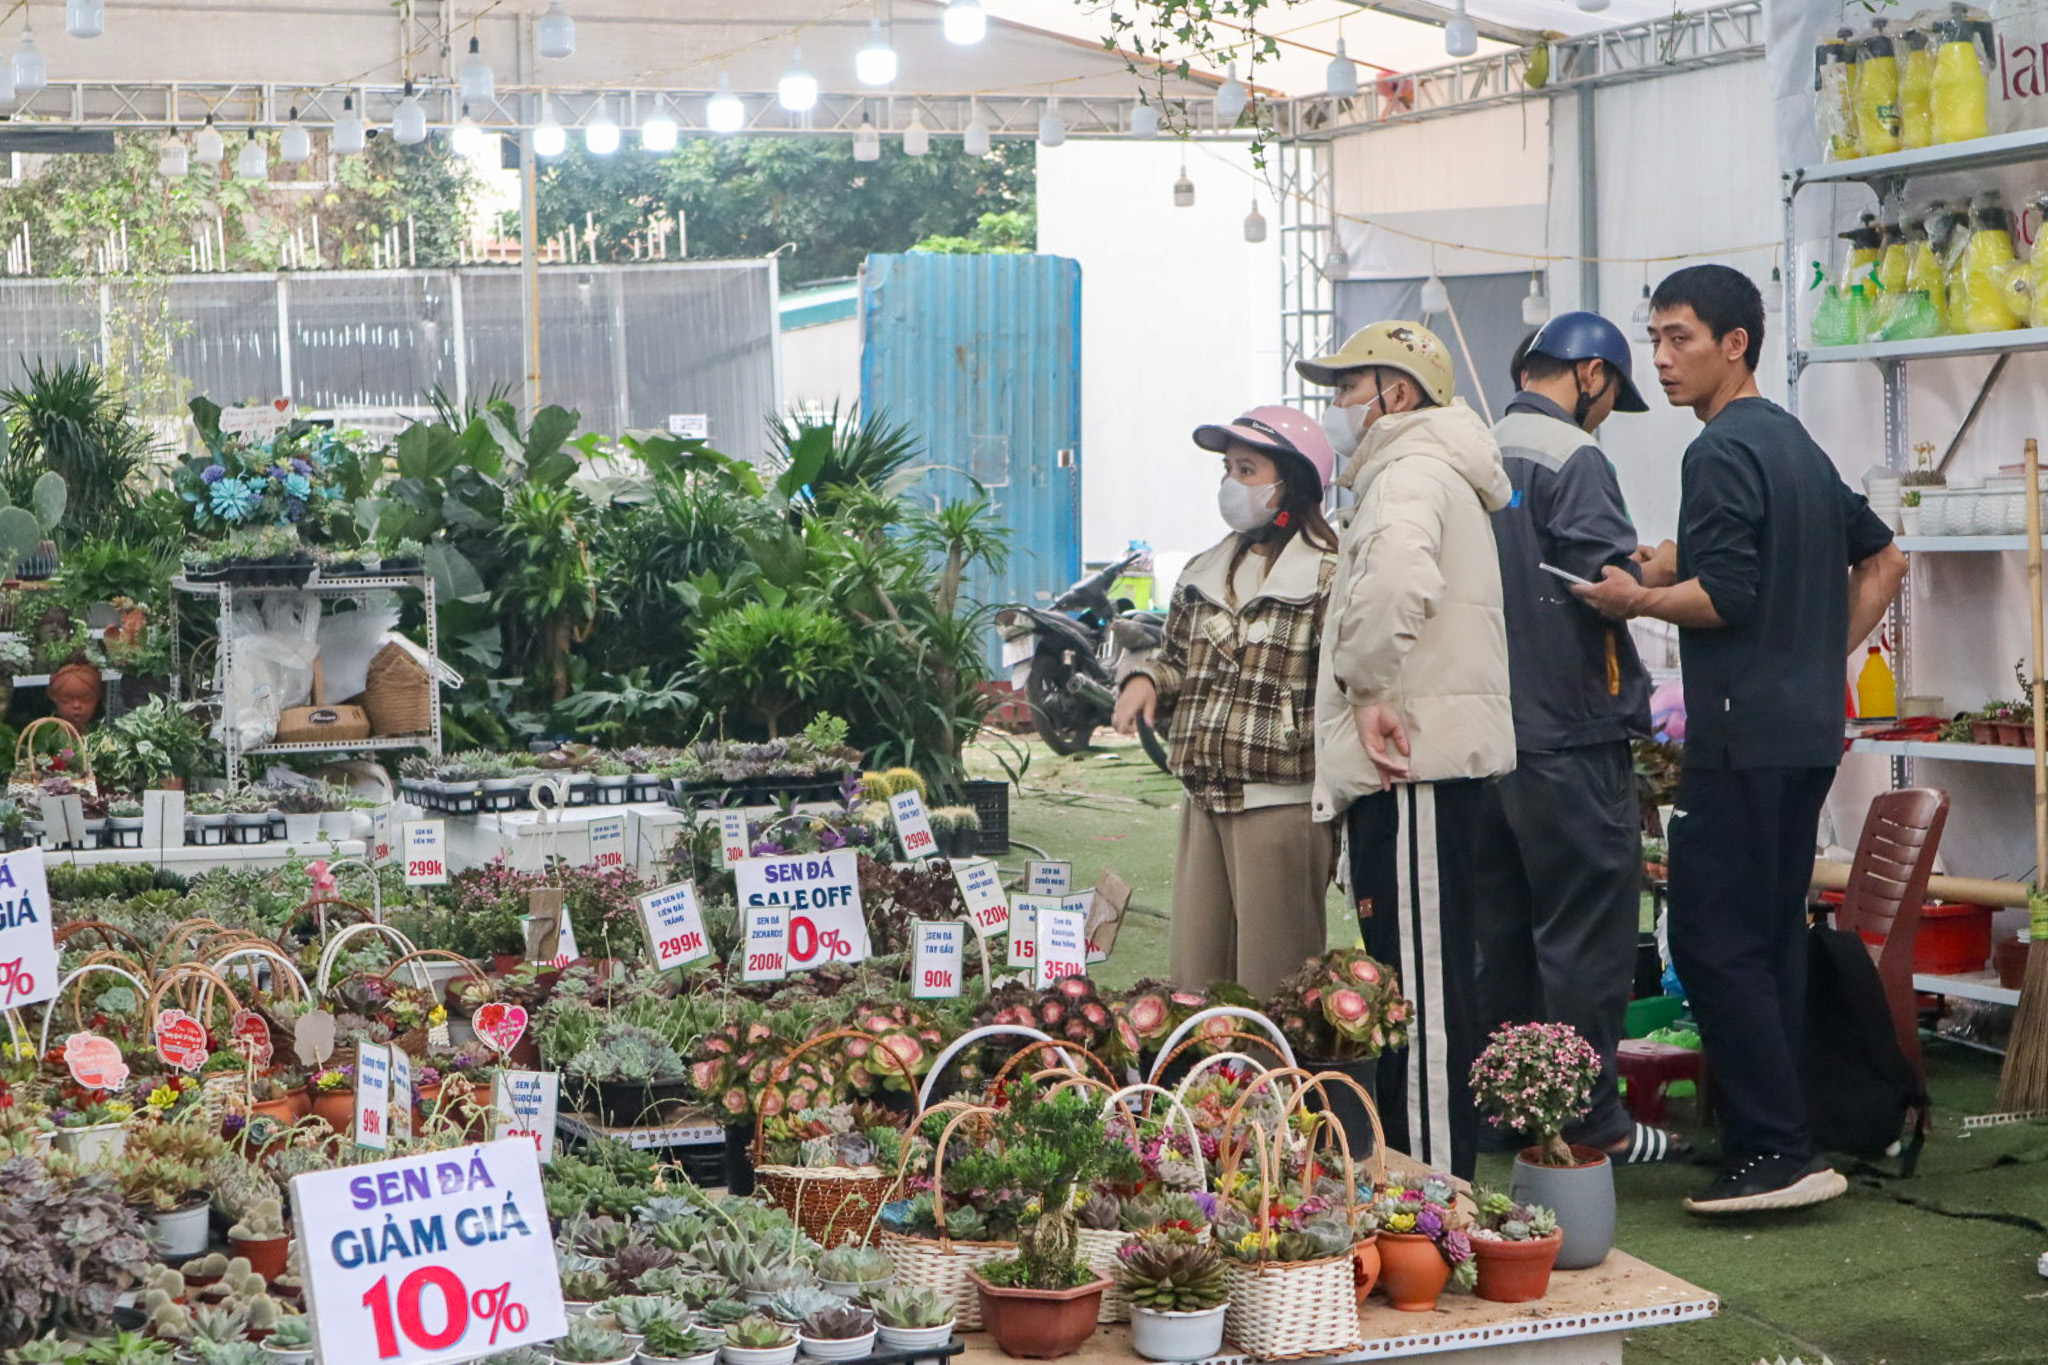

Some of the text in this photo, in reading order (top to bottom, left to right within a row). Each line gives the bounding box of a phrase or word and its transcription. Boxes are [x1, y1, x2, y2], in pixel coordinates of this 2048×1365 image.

[905, 831, 931, 850] 299k
[727, 847, 743, 861] 30k
[409, 860, 442, 876] 299k
[765, 856, 835, 884] SEN ĐÁ
[812, 885, 852, 909] OFF
[757, 916, 770, 925] SEN
[976, 905, 1008, 928] 120k
[659, 931, 702, 960] 299k
[788, 916, 851, 962] 0%
[926, 931, 941, 940] SEN
[1014, 940, 1036, 958] 15
[749, 953, 783, 971] 200k
[1044, 960, 1082, 980] 350k
[924, 970, 952, 988] 90k
[515, 1081, 529, 1089] SEN
[363, 1107, 380, 1134] 99k
[350, 1148, 495, 1211] SEN ĐÁ
[331, 1190, 532, 1269] GIẢM GIÁ
[362, 1265, 529, 1359] 10%
